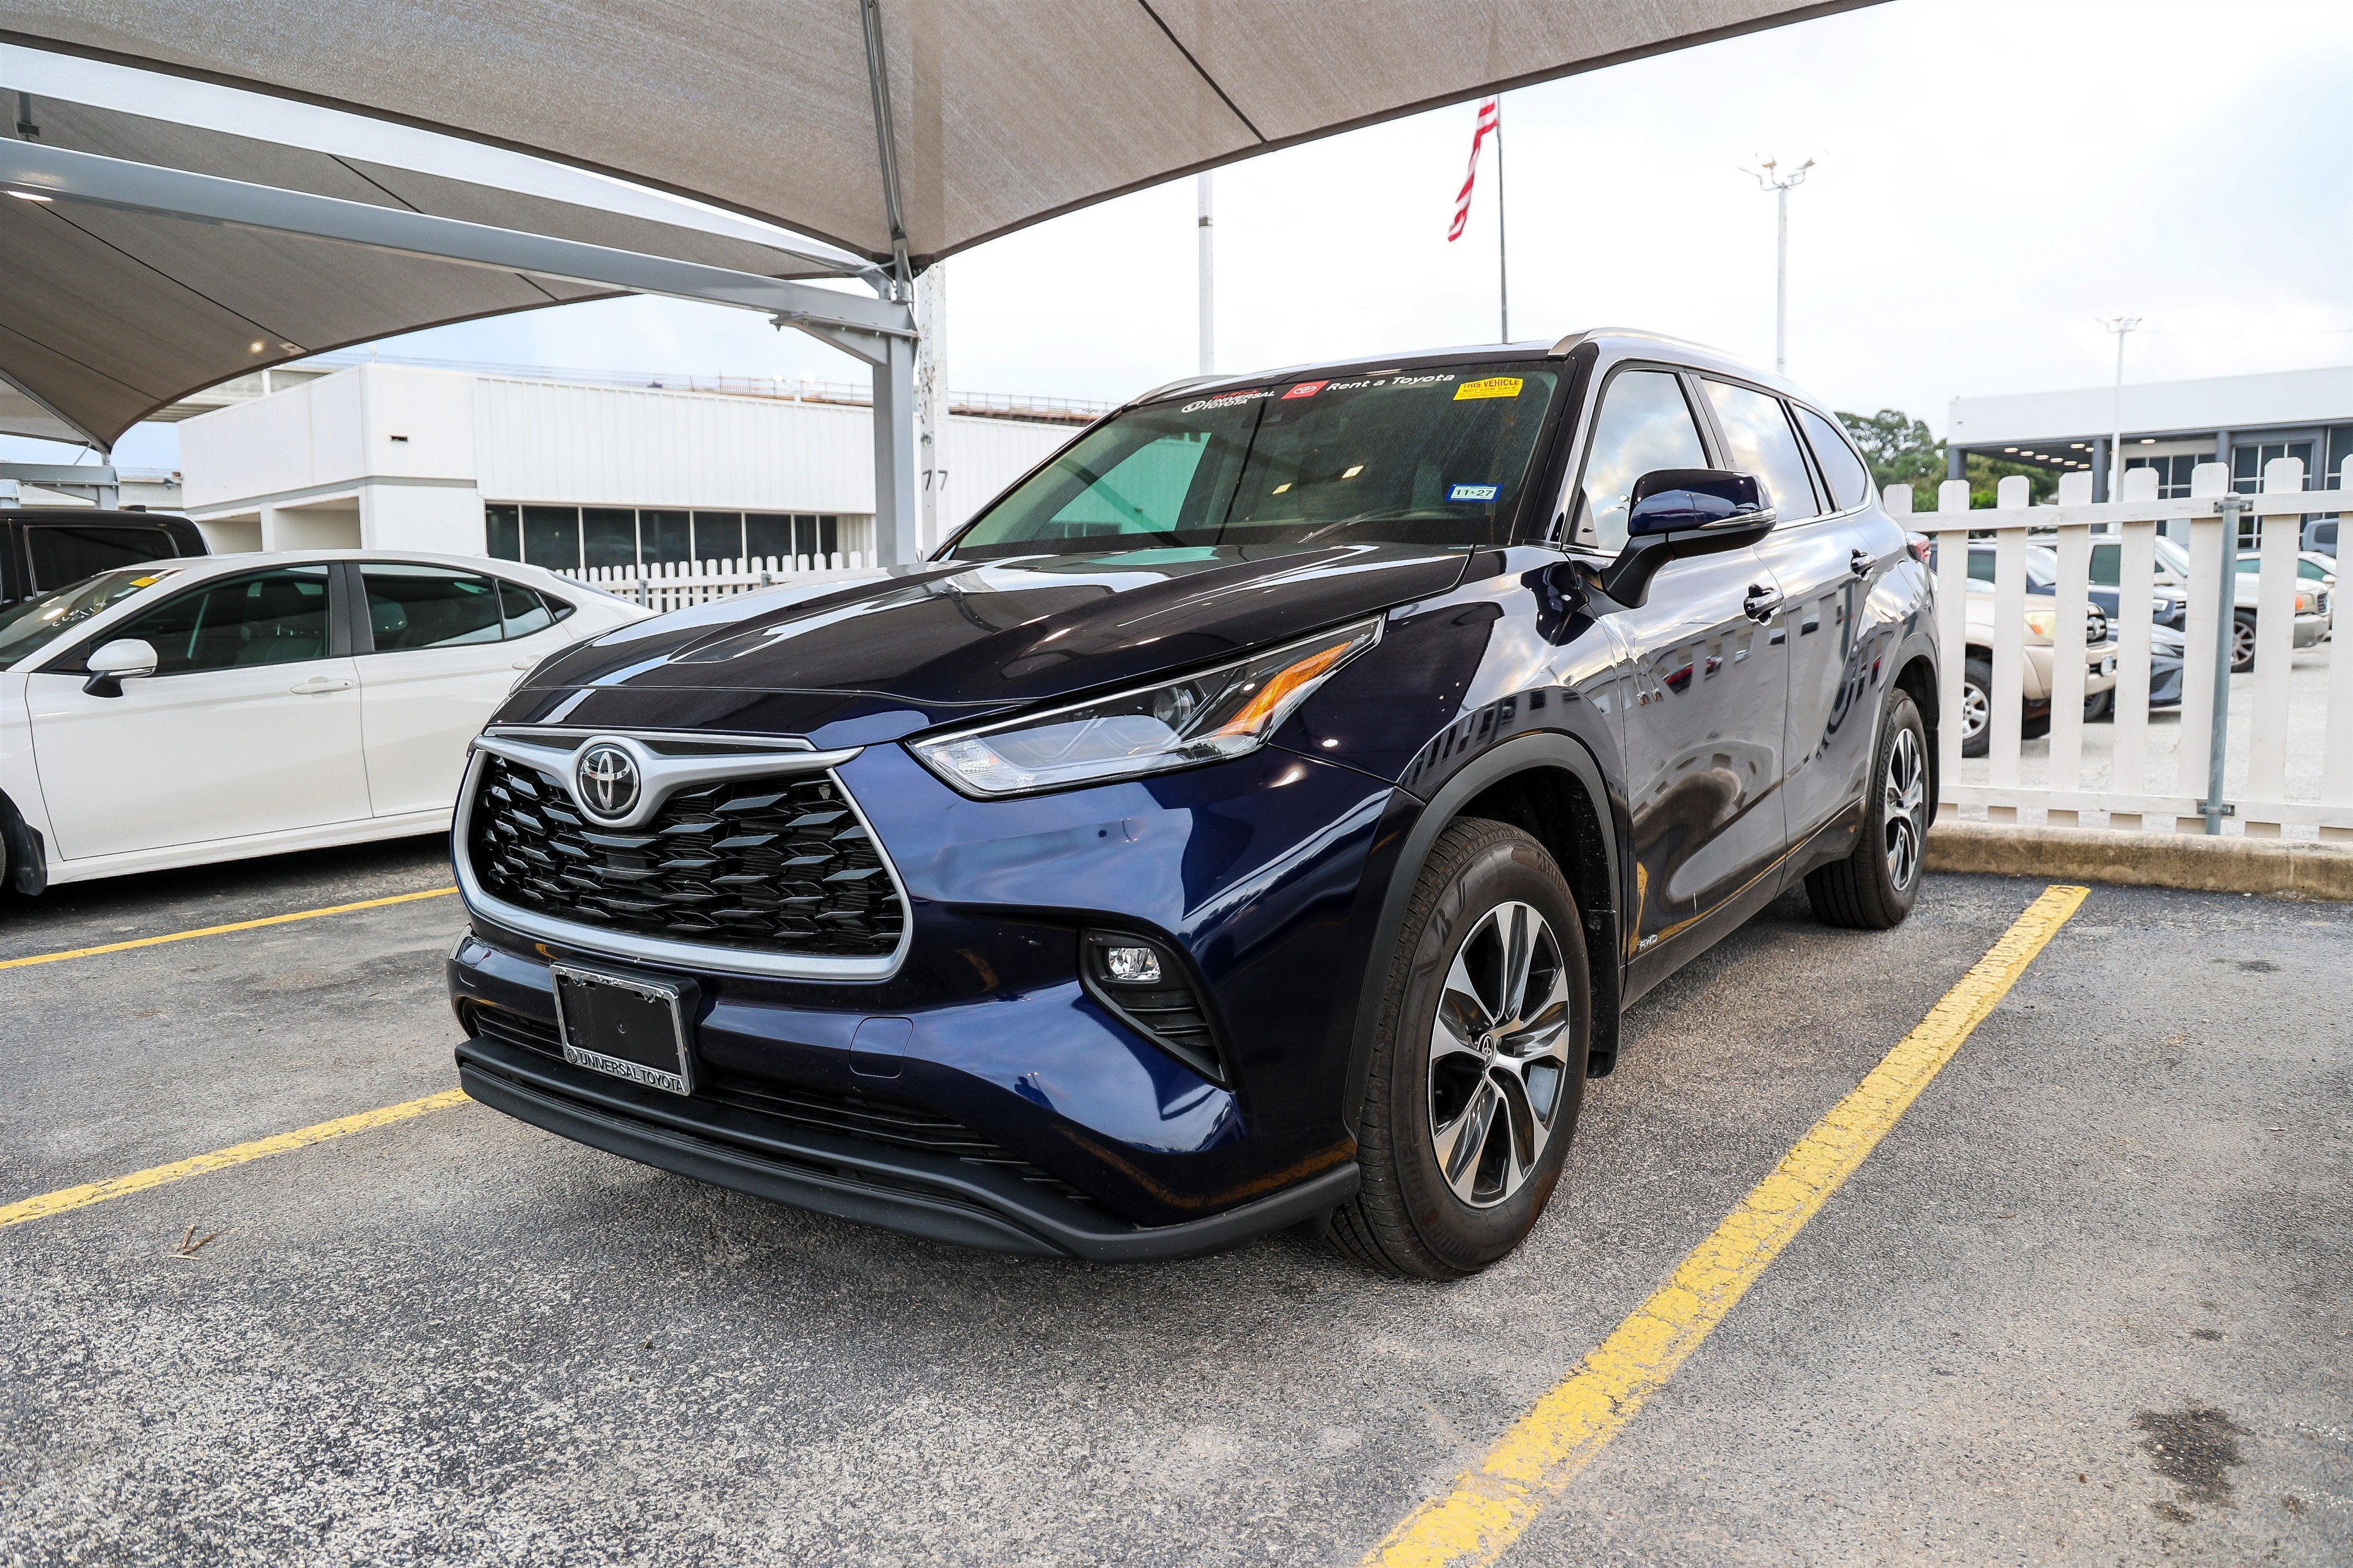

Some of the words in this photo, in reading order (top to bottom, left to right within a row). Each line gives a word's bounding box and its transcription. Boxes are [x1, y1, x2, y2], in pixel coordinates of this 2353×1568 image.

[1326, 379, 1371, 391] Rent
[1391, 374, 1456, 385] Toyota
[1484, 379, 1519, 387] VEHICLE
[1206, 391, 1275, 403] UNIVERSAL
[1202, 399, 1248, 410] TOYOTA
[580, 1052, 641, 1081] UNIVERSAL
[639, 1069, 685, 1092] TOYOTA
